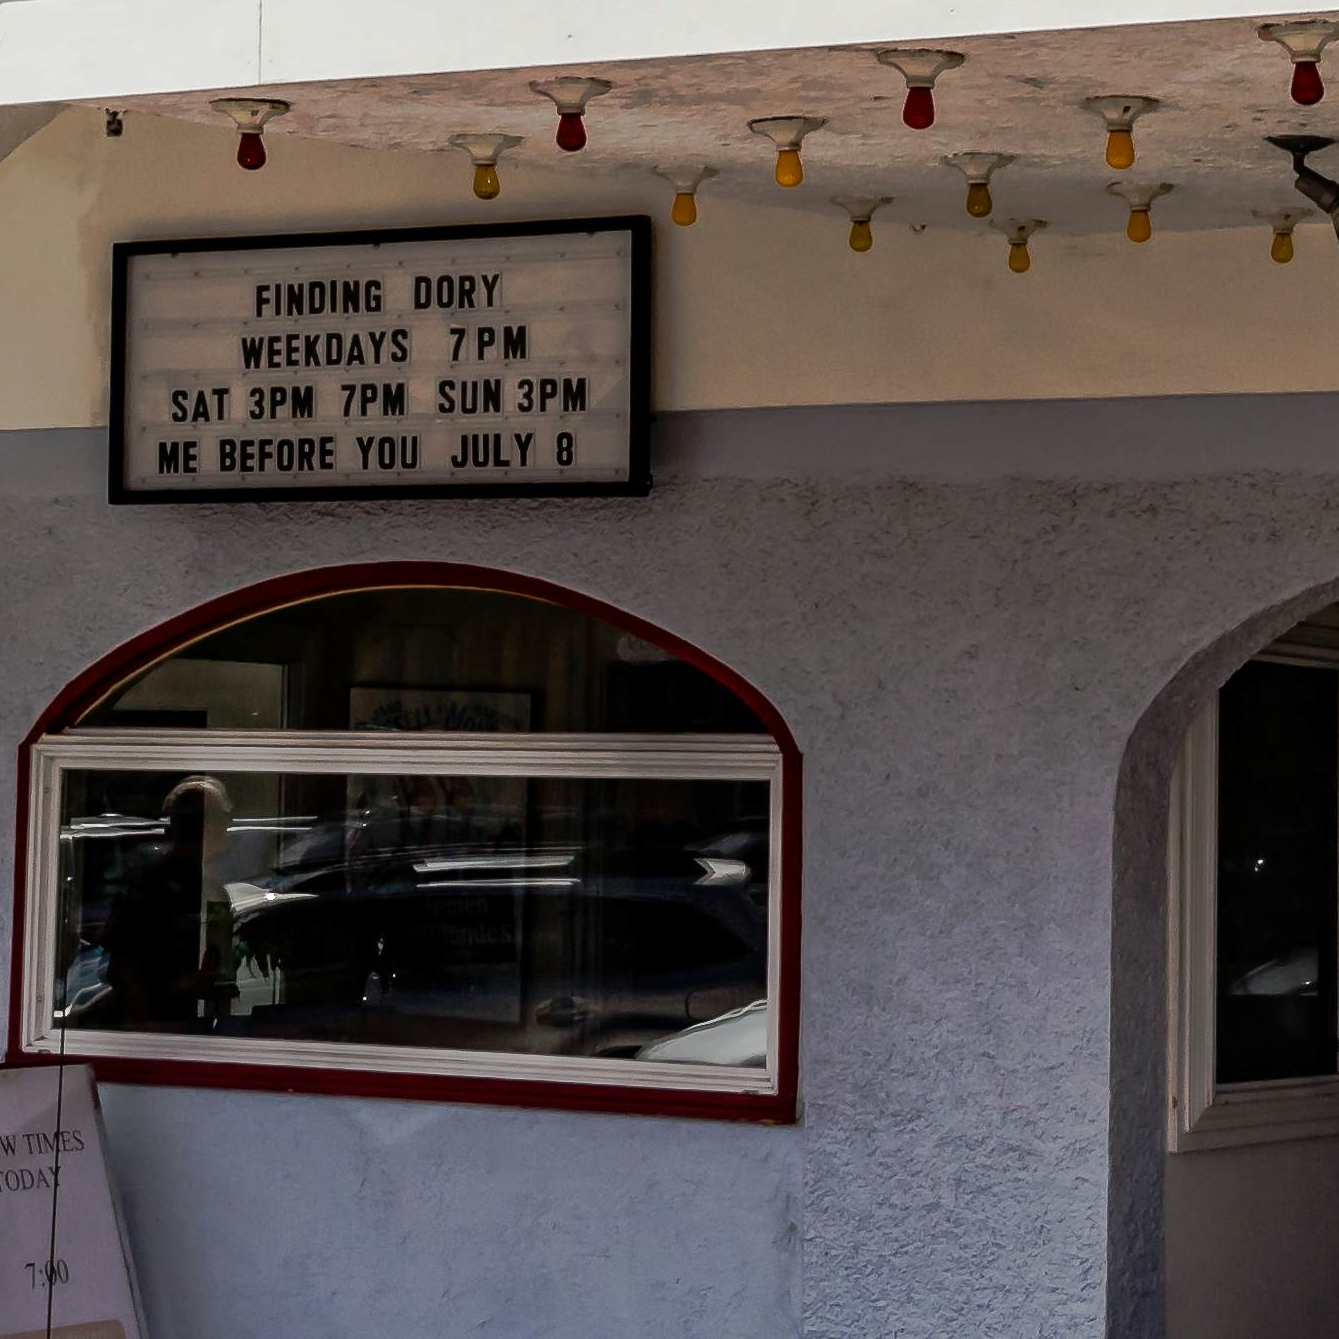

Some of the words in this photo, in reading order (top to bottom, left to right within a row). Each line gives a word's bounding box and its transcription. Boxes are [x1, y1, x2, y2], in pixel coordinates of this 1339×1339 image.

[255, 279, 383, 318] FINDING
[413, 273, 501, 311] DORY
[240, 328, 409, 369] WEEKDAYS
[171, 387, 230, 423] SAT
[249, 384, 315, 421] 3PM
[340, 381, 406, 418] 7PM
[437, 378, 503, 415] SUN
[517, 377, 588, 413] 3PM
[158, 440, 199, 474] ME
[219, 435, 335, 473] BEFORE
[355, 434, 419, 471] YOU
[451, 432, 533, 469] JULY
[556, 431, 575, 467] 8
[22, 1129, 85, 1156] TIMES
[24, 1258, 70, 1289] 7:00
